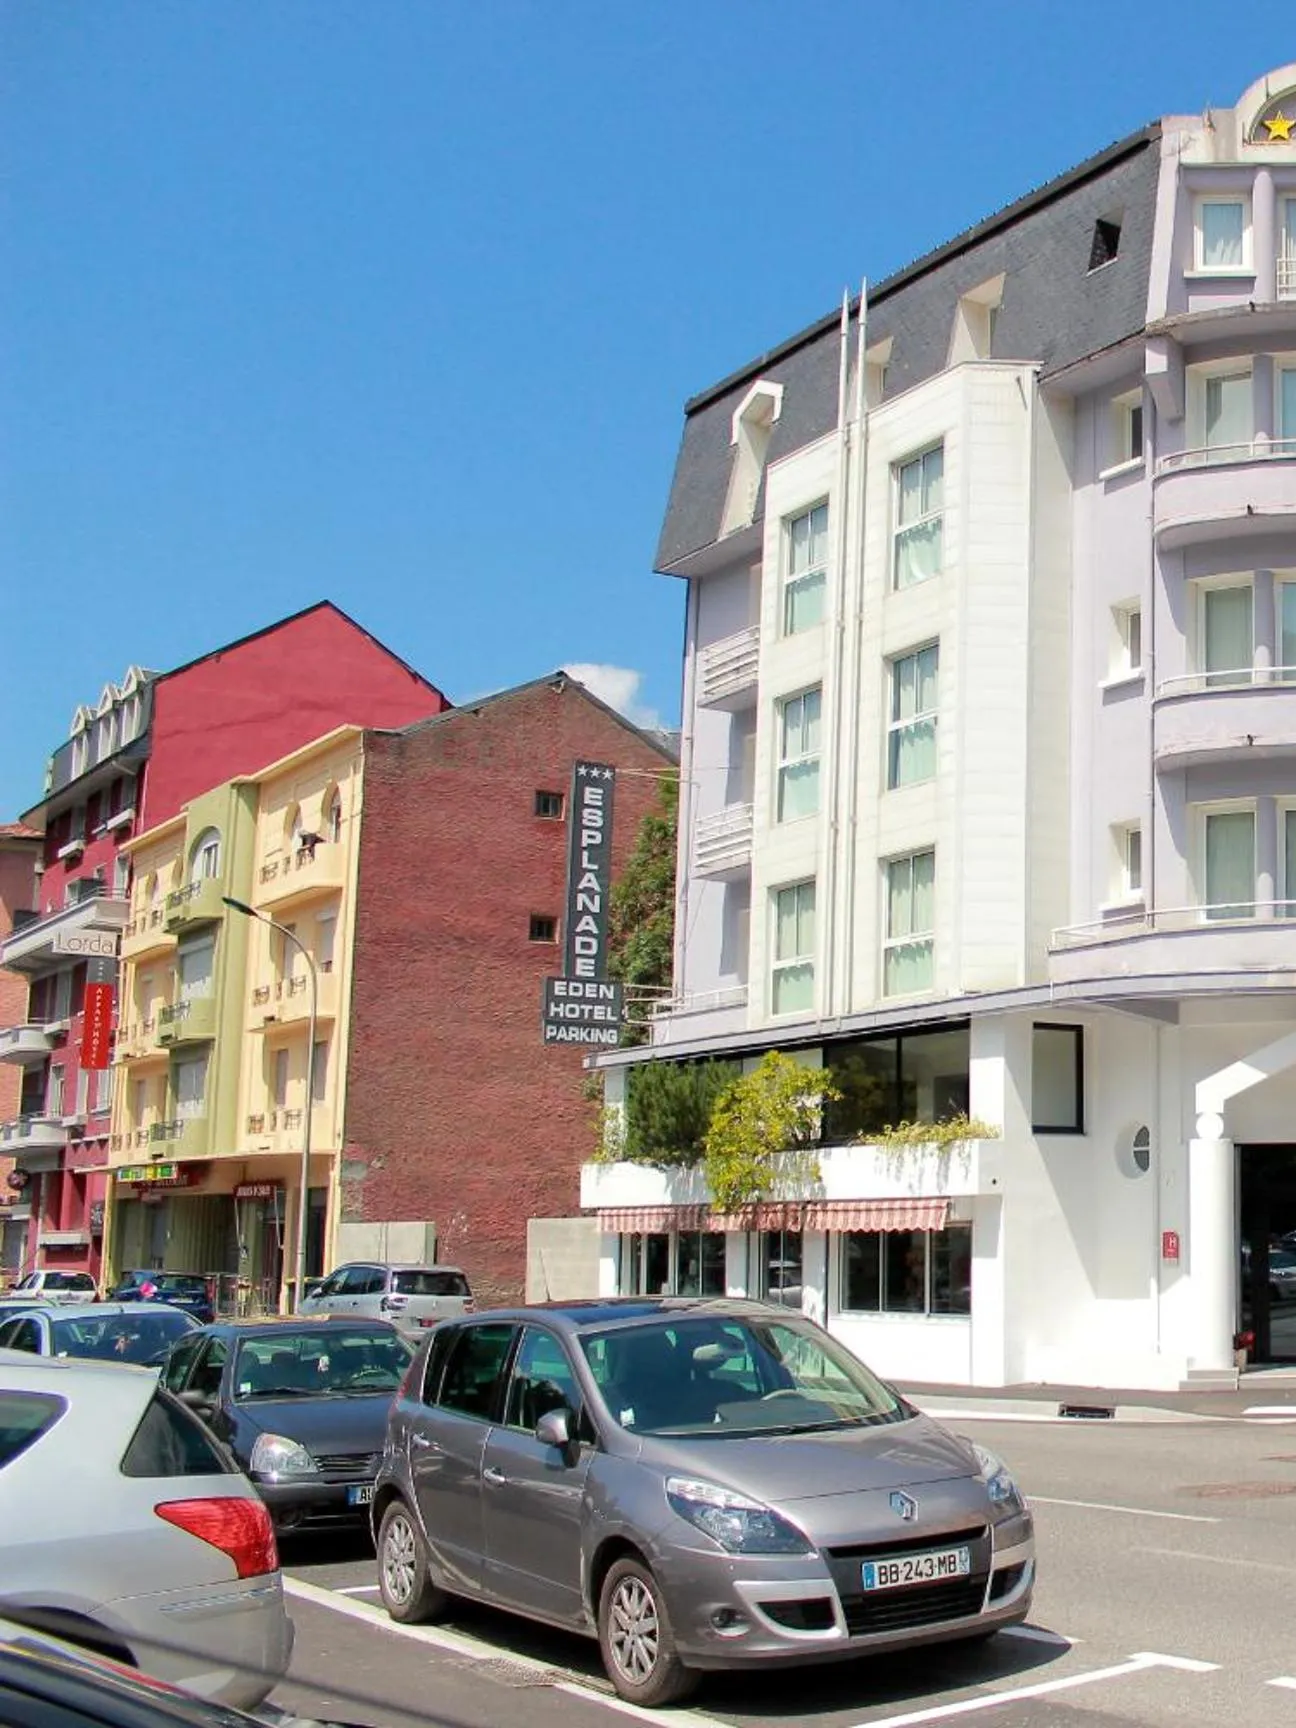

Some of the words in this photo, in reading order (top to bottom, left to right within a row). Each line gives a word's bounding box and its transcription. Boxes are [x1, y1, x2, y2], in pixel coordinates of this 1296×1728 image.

[574, 786, 604, 978] ESPLANADE
[58, 931, 113, 954] Lorda
[554, 981, 614, 999] EDEN
[549, 1002, 617, 1020] HOTEL
[546, 1025, 617, 1044] PARKING
